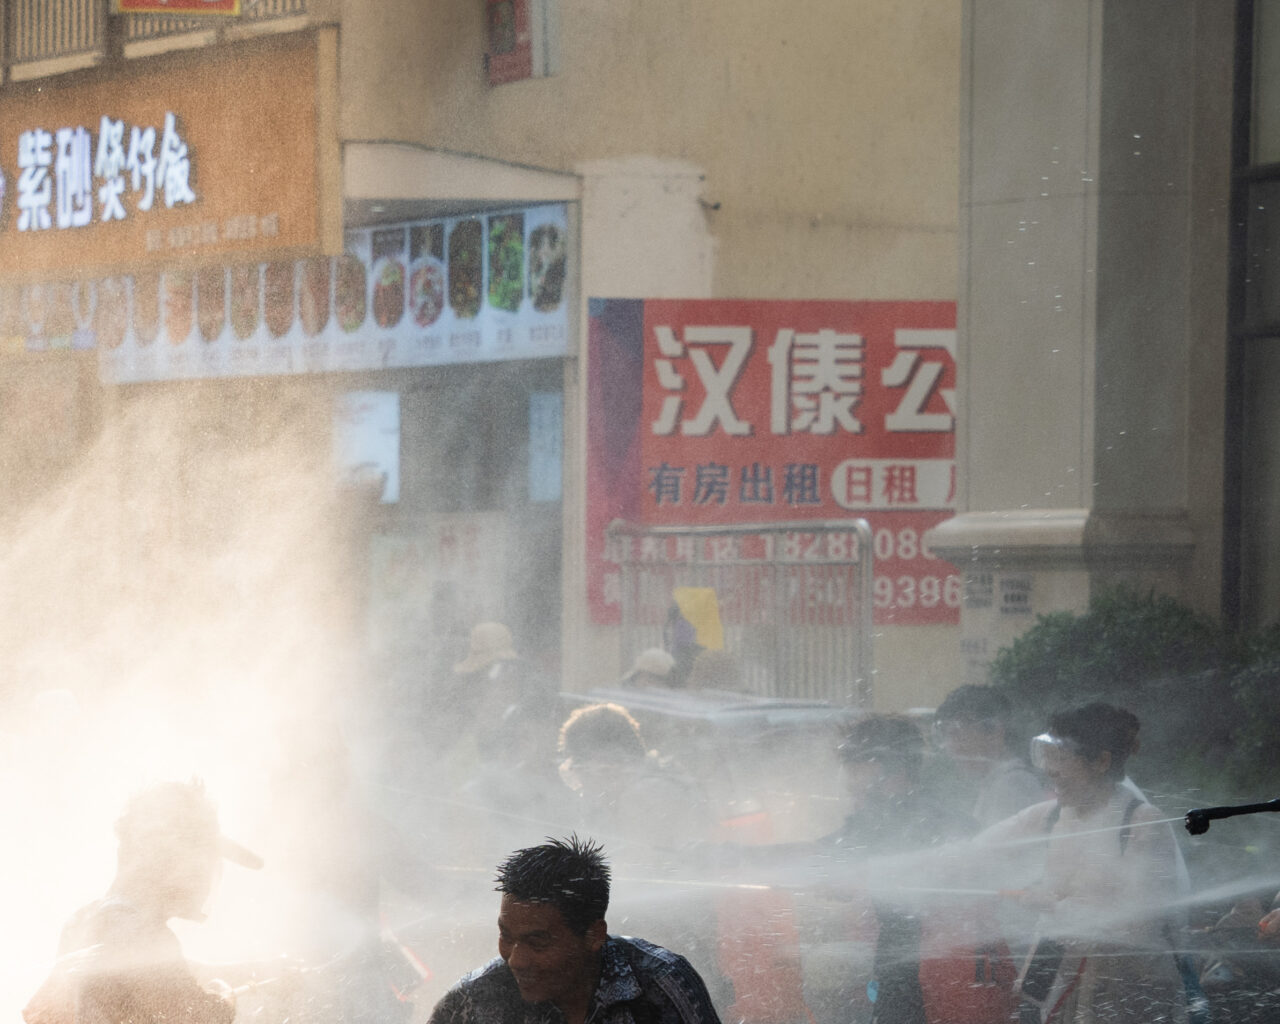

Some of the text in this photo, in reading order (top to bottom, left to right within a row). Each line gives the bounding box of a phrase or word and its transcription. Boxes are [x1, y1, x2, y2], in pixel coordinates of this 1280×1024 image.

[651, 325, 957, 436] 汉傣公
[648, 462, 819, 506] 有房出租
[845, 464, 918, 505] 日租
